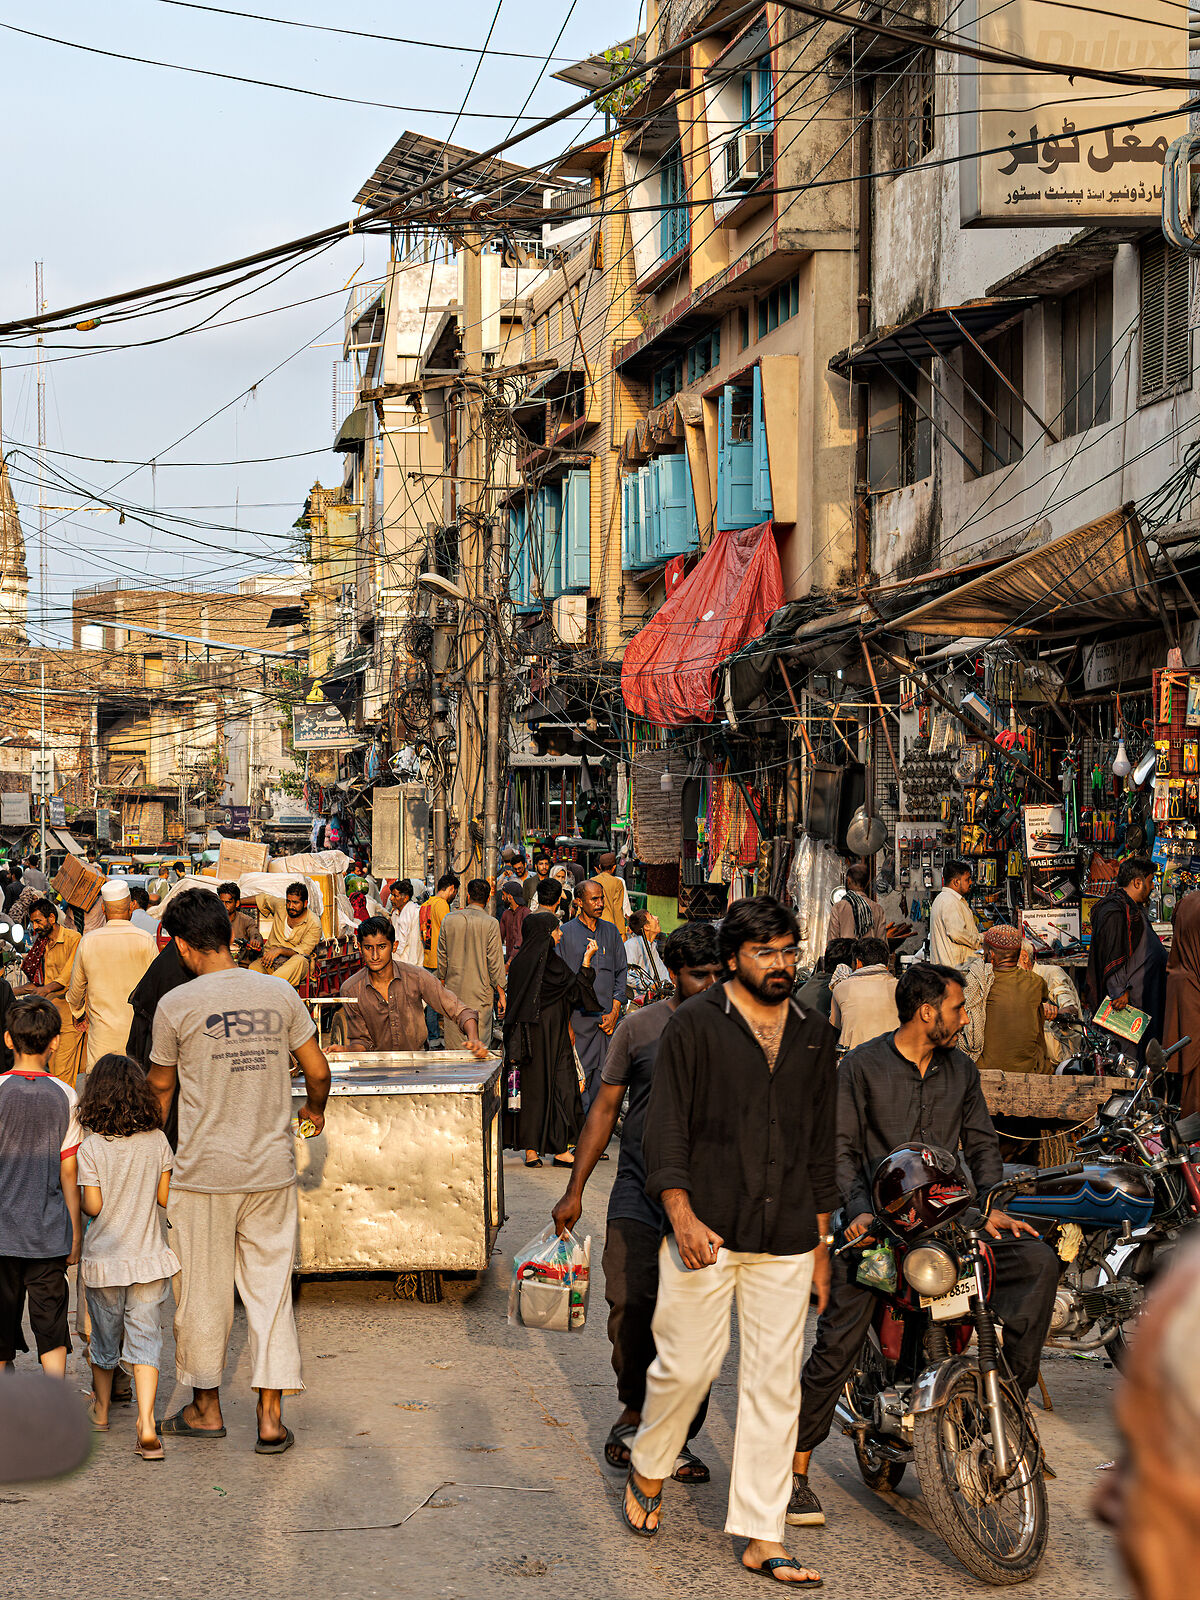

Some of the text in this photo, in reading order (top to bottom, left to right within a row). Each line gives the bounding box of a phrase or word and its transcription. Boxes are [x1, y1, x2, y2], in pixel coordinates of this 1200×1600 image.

[1034, 30, 1181, 67] Dulux
[1030, 857, 1076, 867] MAGIC SCALE
[222, 1008, 284, 1037] FSBD
